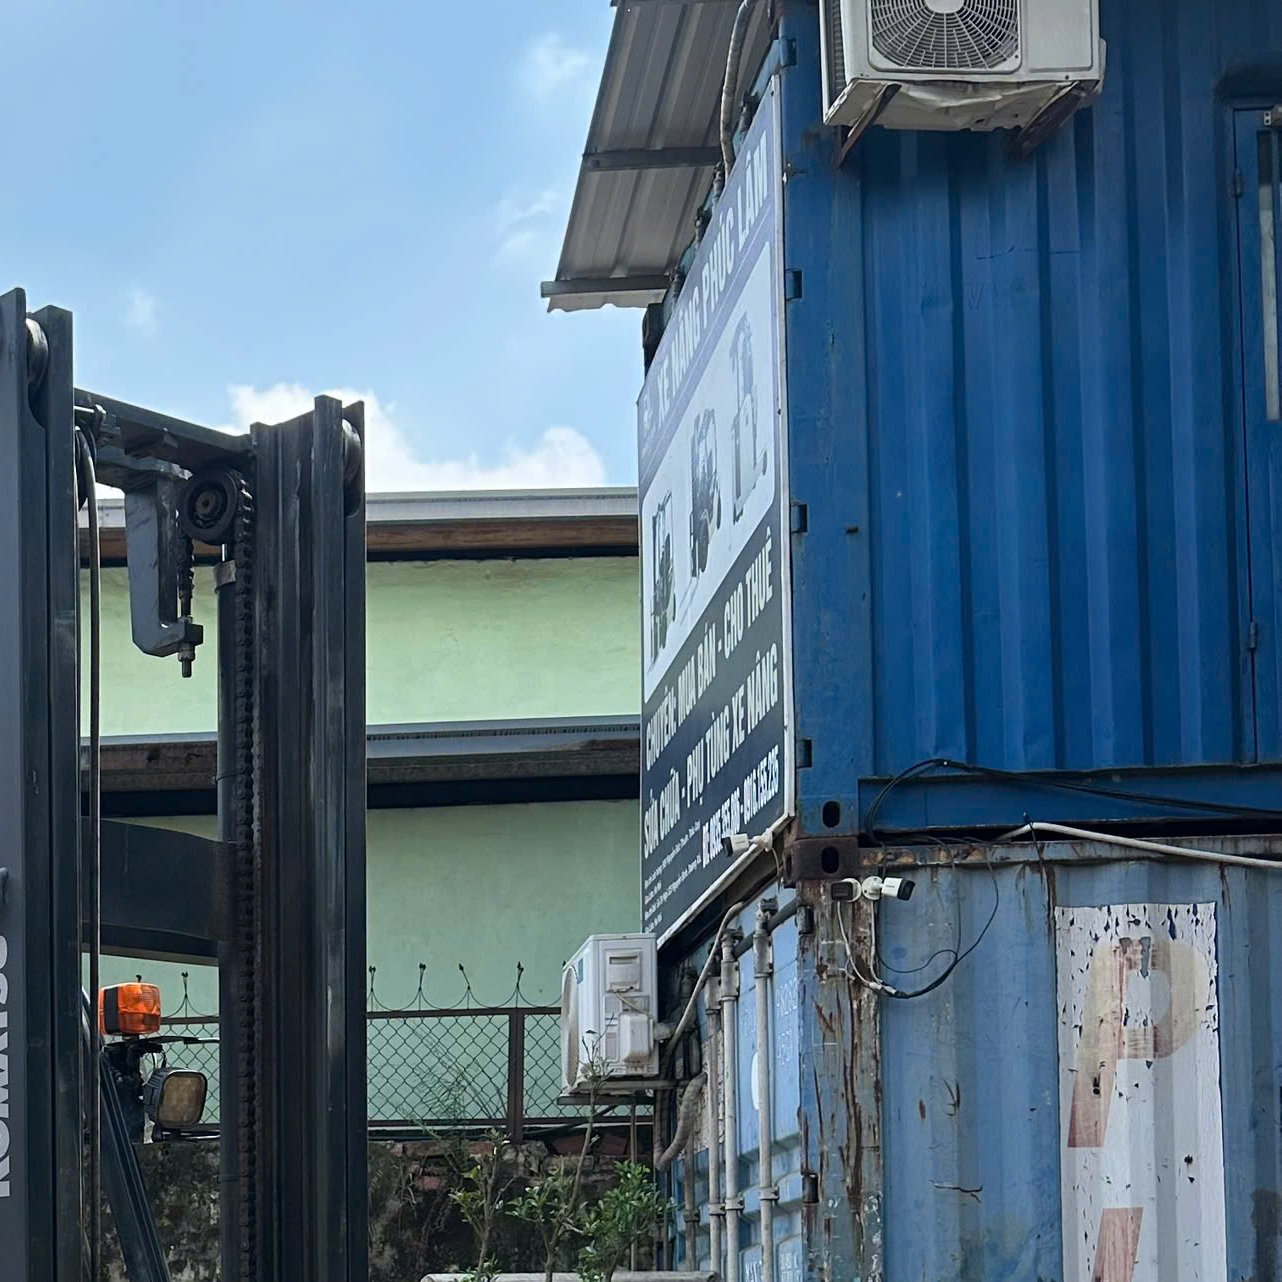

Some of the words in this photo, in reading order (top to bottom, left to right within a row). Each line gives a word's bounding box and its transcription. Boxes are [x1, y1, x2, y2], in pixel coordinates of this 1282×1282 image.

[657, 355, 671, 430] XE
[671, 285, 701, 396] NÂNG
[702, 207, 735, 329] PHÚC
[737, 130, 768, 253] LÂM
[677, 654, 696, 727] MUA
[697, 621, 716, 699] BÁN
[724, 581, 744, 660] CHO
[745, 525, 773, 629] THUÊ
[686, 738, 704, 808] PHỤ
[705, 704, 730, 784] TÙNG
[731, 683, 745, 754] XE
[746, 642, 778, 735] NÂNG
